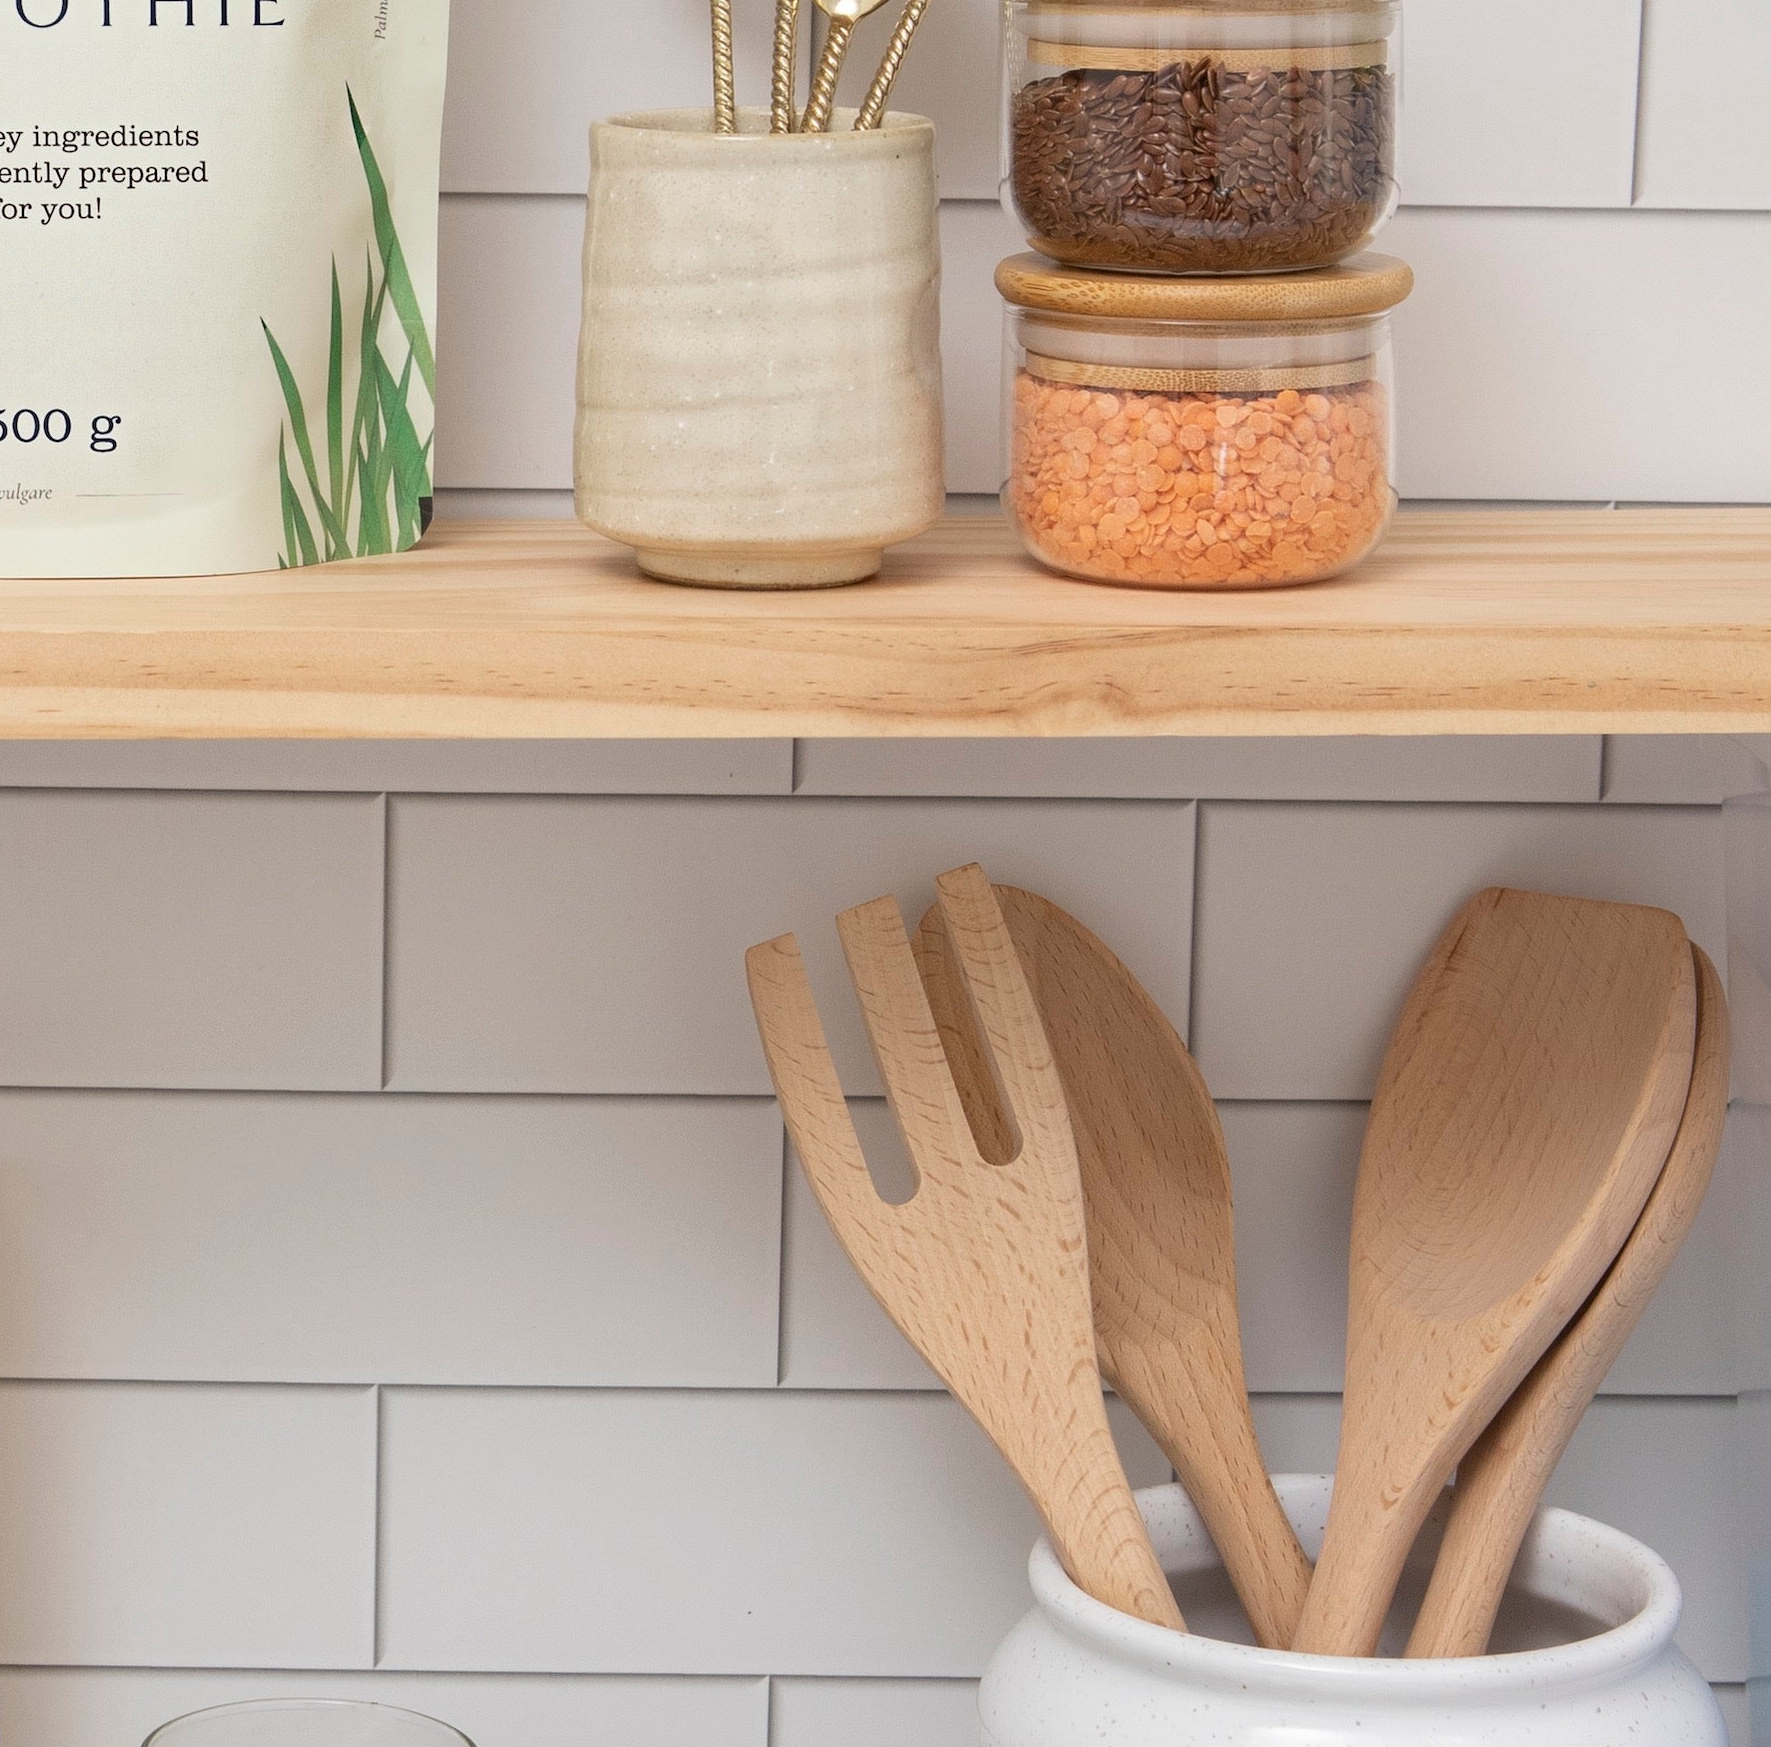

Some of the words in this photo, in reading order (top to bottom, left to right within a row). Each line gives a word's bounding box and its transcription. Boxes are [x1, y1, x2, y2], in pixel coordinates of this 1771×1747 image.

[32, 124, 200, 154] ingredients
[78, 160, 209, 190] prepared
[40, 196, 102, 226] you!
[89, 415, 122, 453] g
